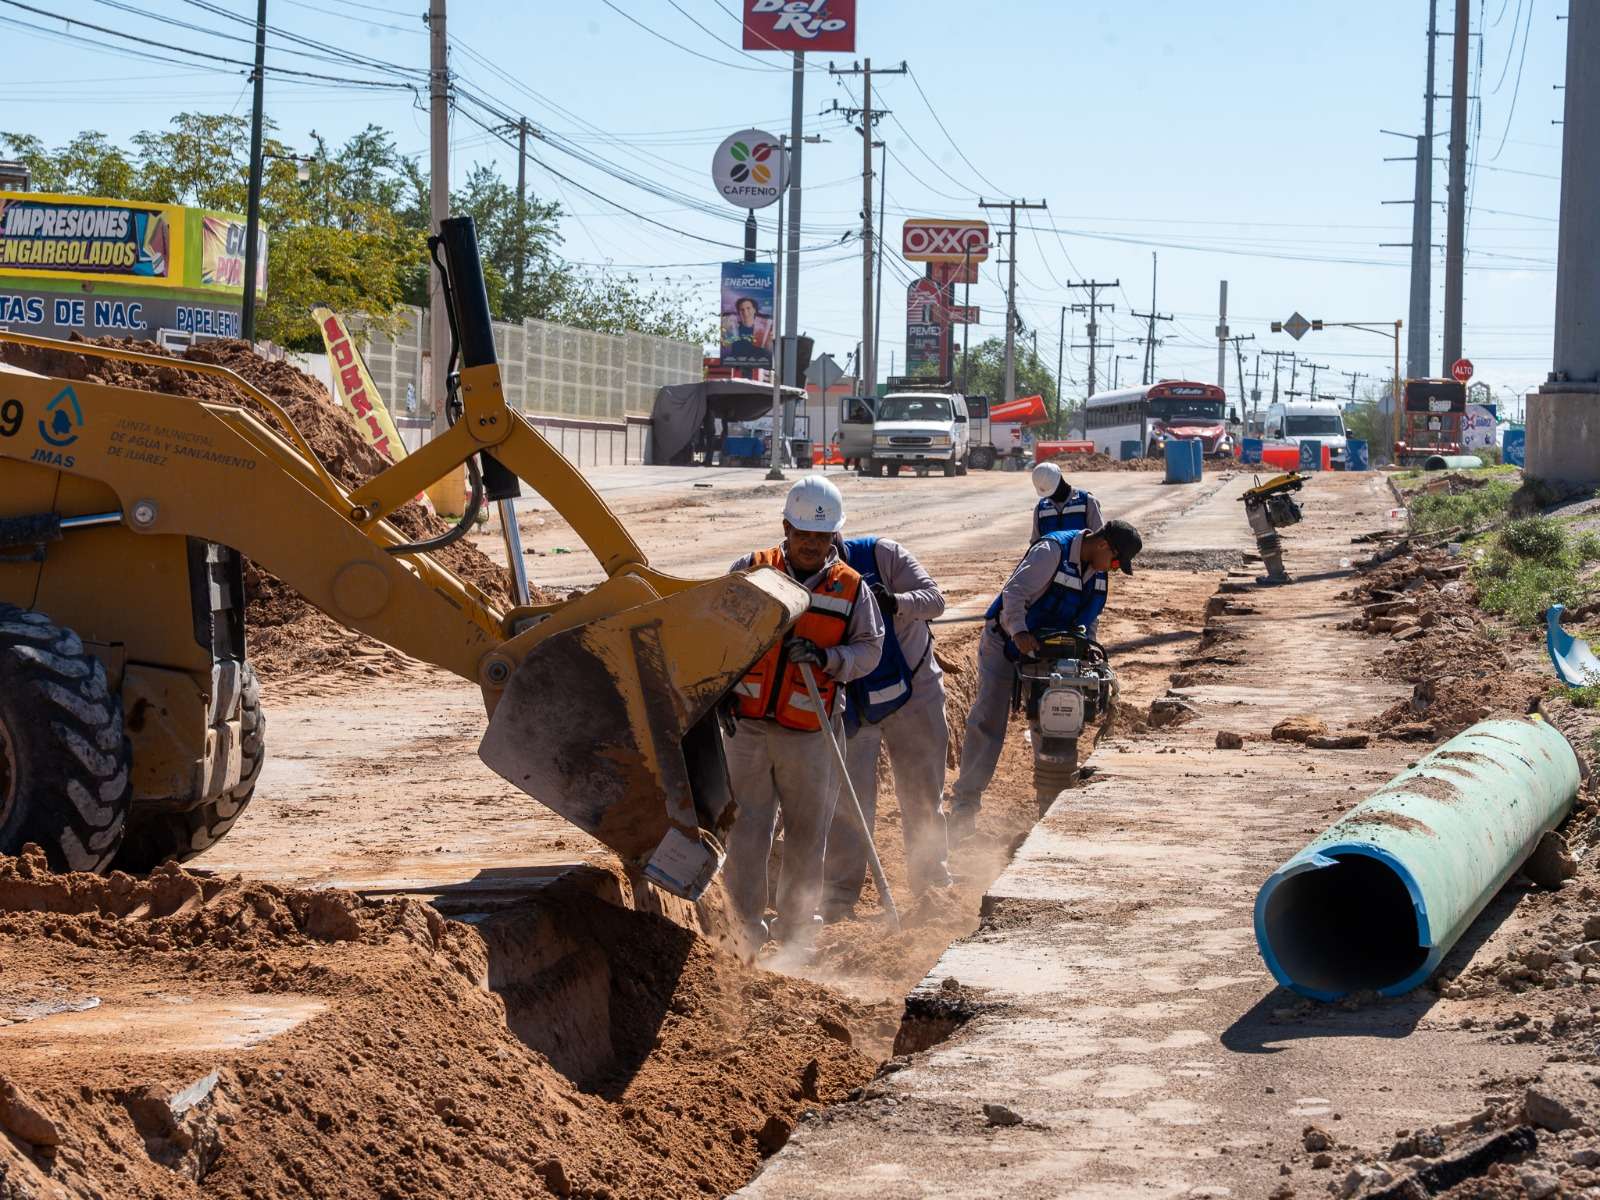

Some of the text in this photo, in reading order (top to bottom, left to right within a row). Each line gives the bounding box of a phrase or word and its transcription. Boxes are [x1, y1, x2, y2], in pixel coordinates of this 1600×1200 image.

[751, 0, 824, 13] Del
[773, 12, 847, 38] Rio
[723, 185, 777, 196] CAFFENIO
[4, 207, 130, 239] IMPRESIONES
[905, 228, 985, 254] OXXO
[54, 299, 85, 327] DE
[95, 302, 147, 329] NAC.
[1455, 366, 1472, 375] ALTO
[0, 399, 24, 437] 9
[31, 448, 76, 468] JMAS
[107, 446, 123, 456] DE
[110, 431, 126, 442] DE
[128, 435, 160, 450] AGUA
[174, 445, 256, 470] SANEAMIENTO
